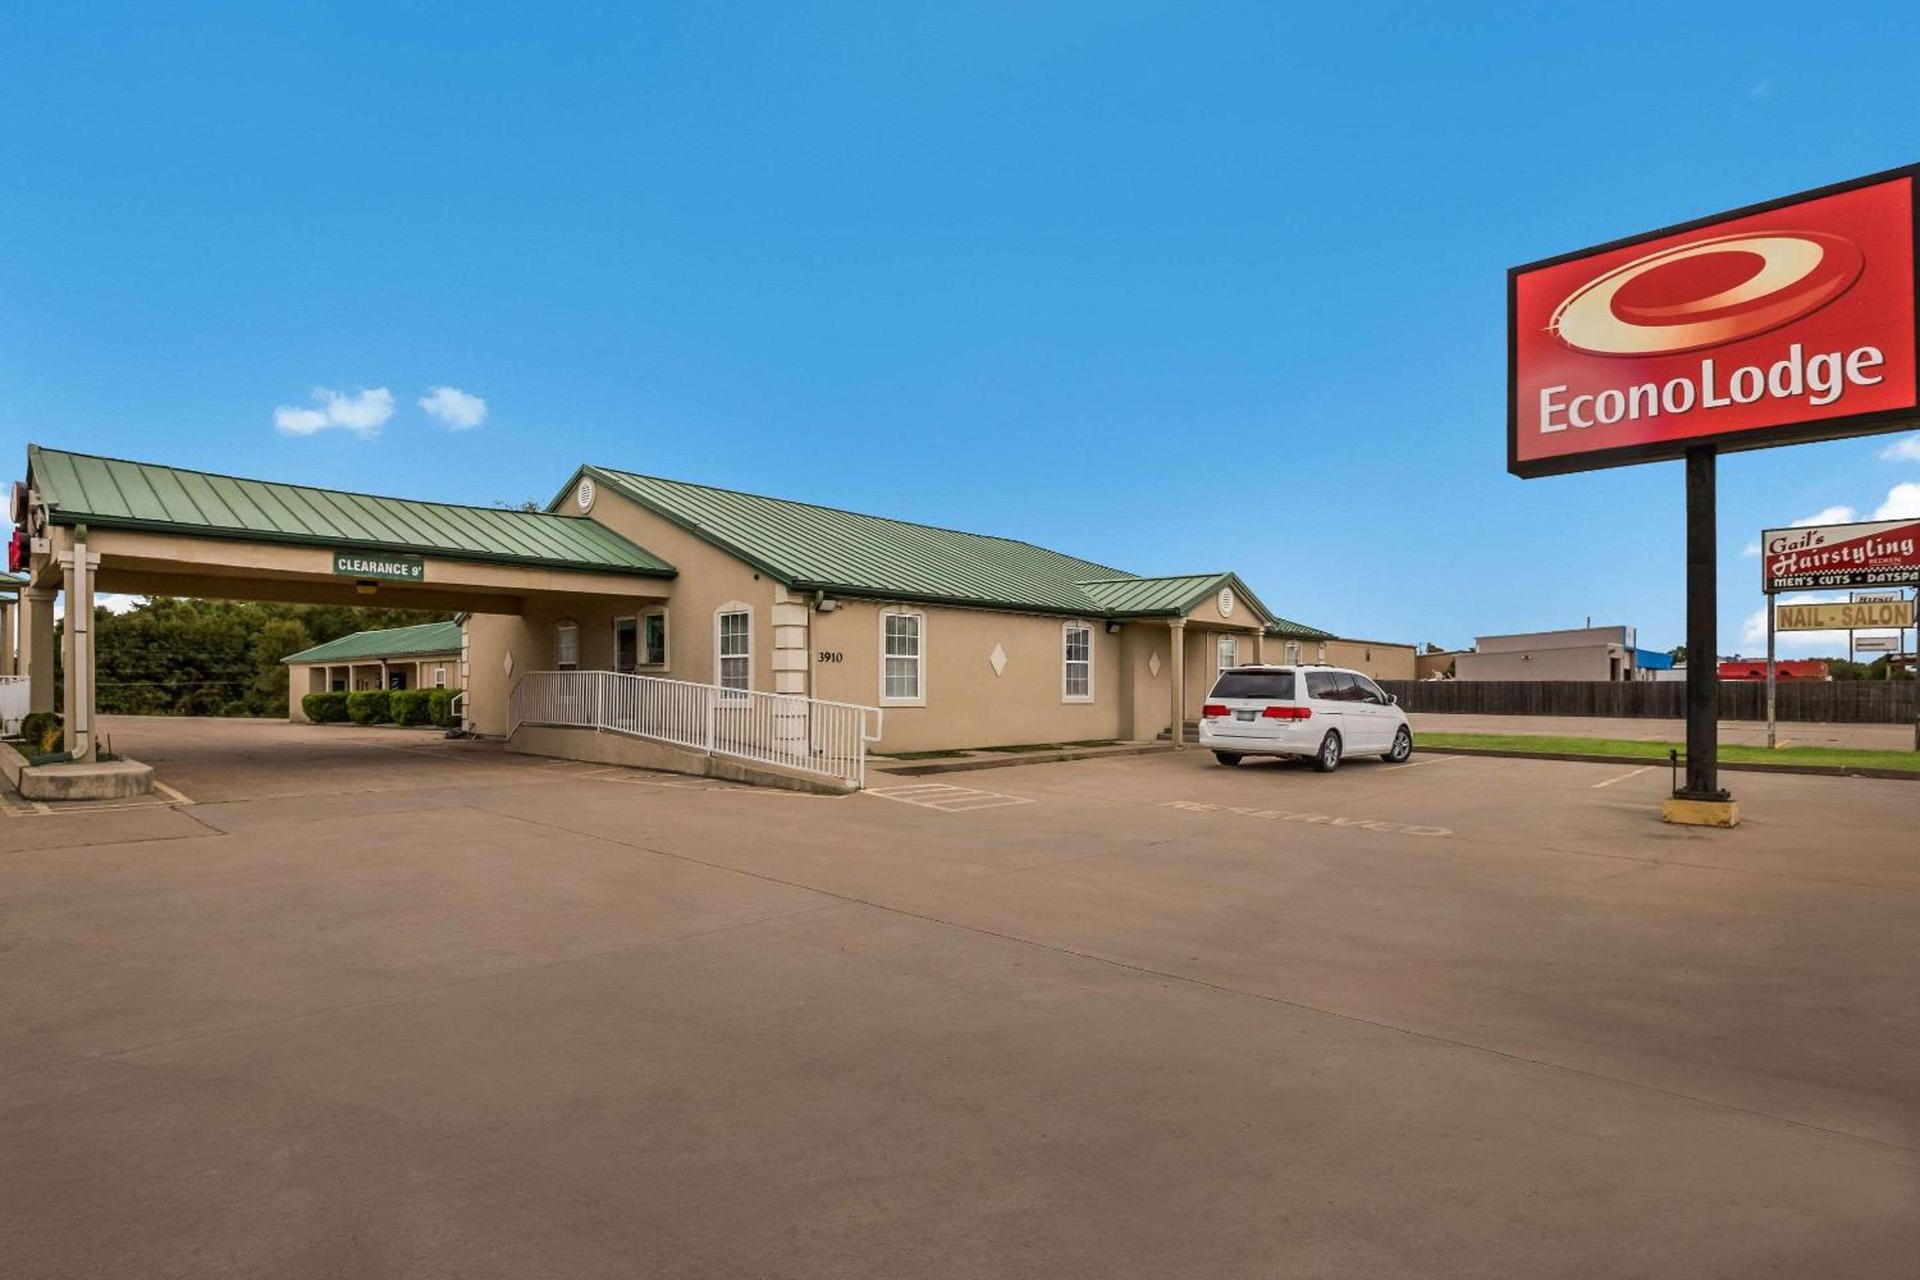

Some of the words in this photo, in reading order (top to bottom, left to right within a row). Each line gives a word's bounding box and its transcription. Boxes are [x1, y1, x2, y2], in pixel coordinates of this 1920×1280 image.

[1540, 343, 1884, 433] EconoLodge
[1769, 530, 1825, 554] Gail's
[338, 558, 409, 576] CLEARANCE
[1772, 538, 1914, 575] Hairstyling
[1774, 576, 1814, 587] MEN'S
[1818, 574, 1850, 585] CUTS
[1867, 571, 1919, 583] DAYSPA
[1781, 608, 1824, 627] NAIL
[1841, 604, 1908, 626] SALON
[818, 651, 843, 663] 3910
